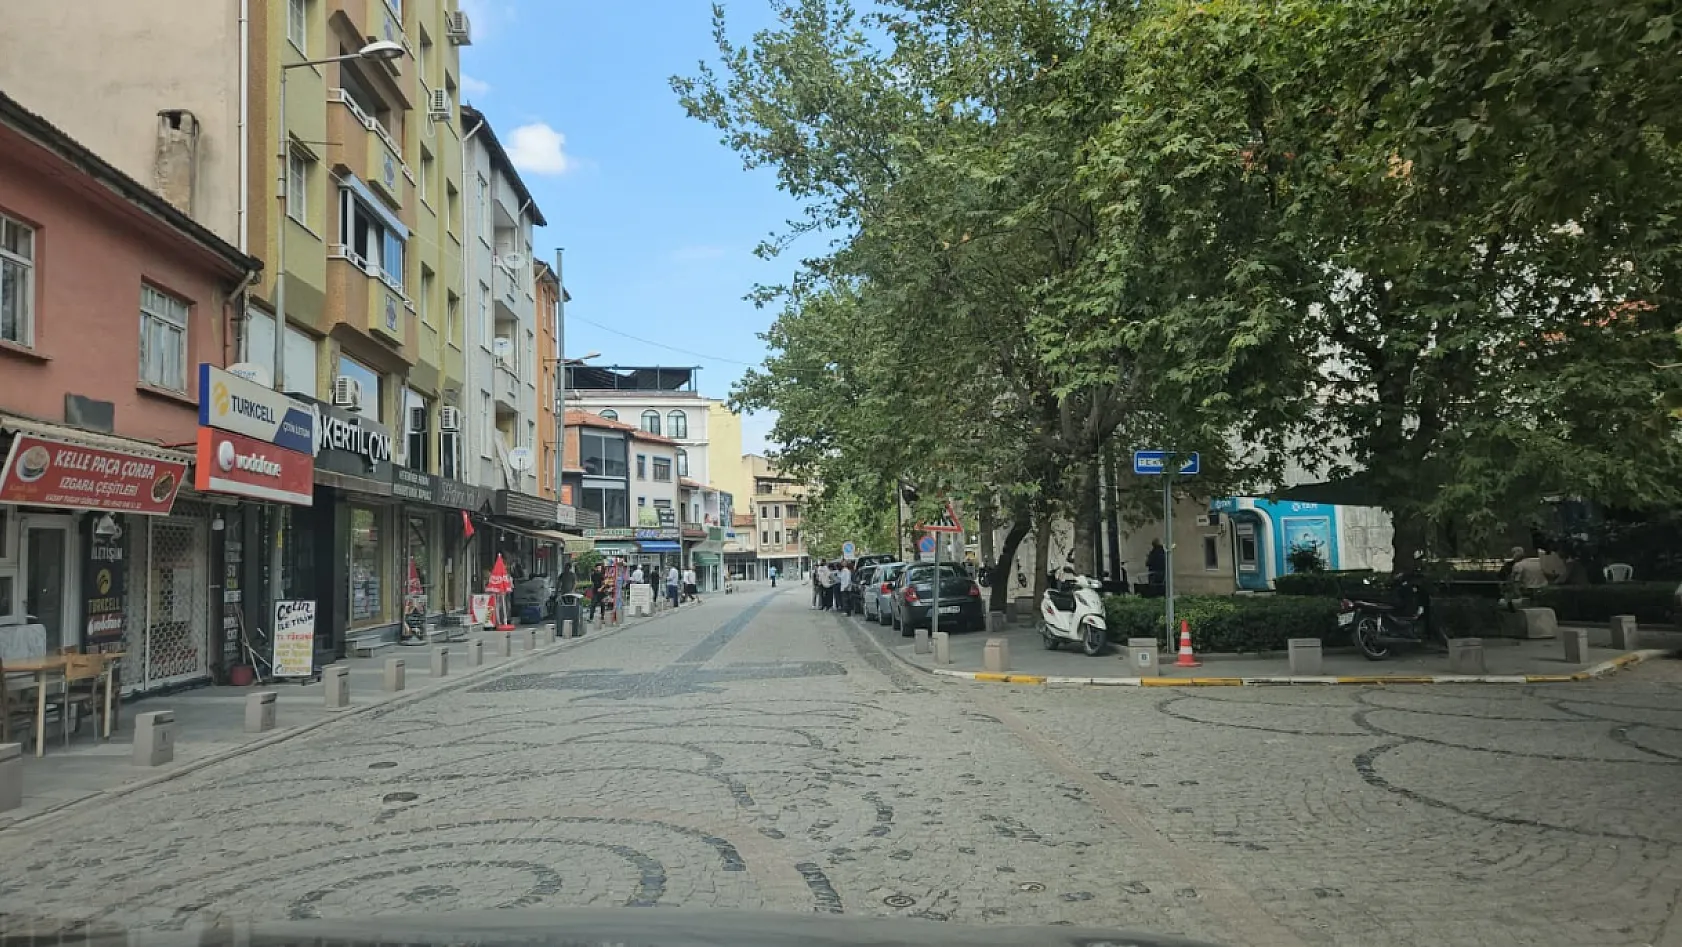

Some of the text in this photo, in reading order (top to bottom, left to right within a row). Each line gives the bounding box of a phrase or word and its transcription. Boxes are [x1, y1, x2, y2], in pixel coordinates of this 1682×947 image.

[231, 395, 276, 425] TURKCELL
[323, 414, 369, 455] KERTİL
[54, 449, 156, 481] KELLE PAÇA ÇORBA
[236, 453, 282, 477] vodafone
[59, 476, 94, 491] IZGARA
